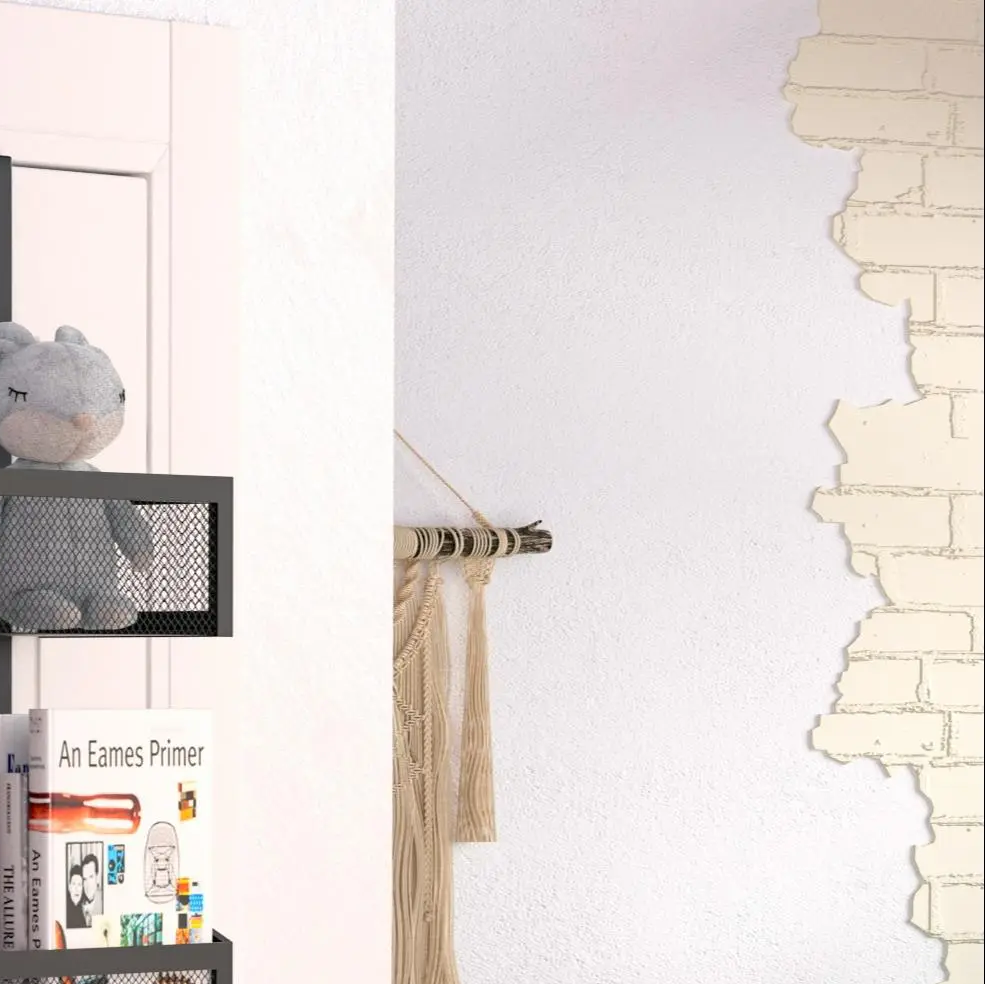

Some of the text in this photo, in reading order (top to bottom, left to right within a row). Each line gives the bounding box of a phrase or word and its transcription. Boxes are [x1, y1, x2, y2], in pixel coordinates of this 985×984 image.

[59, 740, 81, 767] An
[88, 740, 144, 767] Eames
[150, 740, 205, 767] Primer
[31, 849, 41, 871] An
[3, 865, 14, 893] THE
[31, 878, 41, 933] Eames
[3, 896, 14, 949] ALLURE
